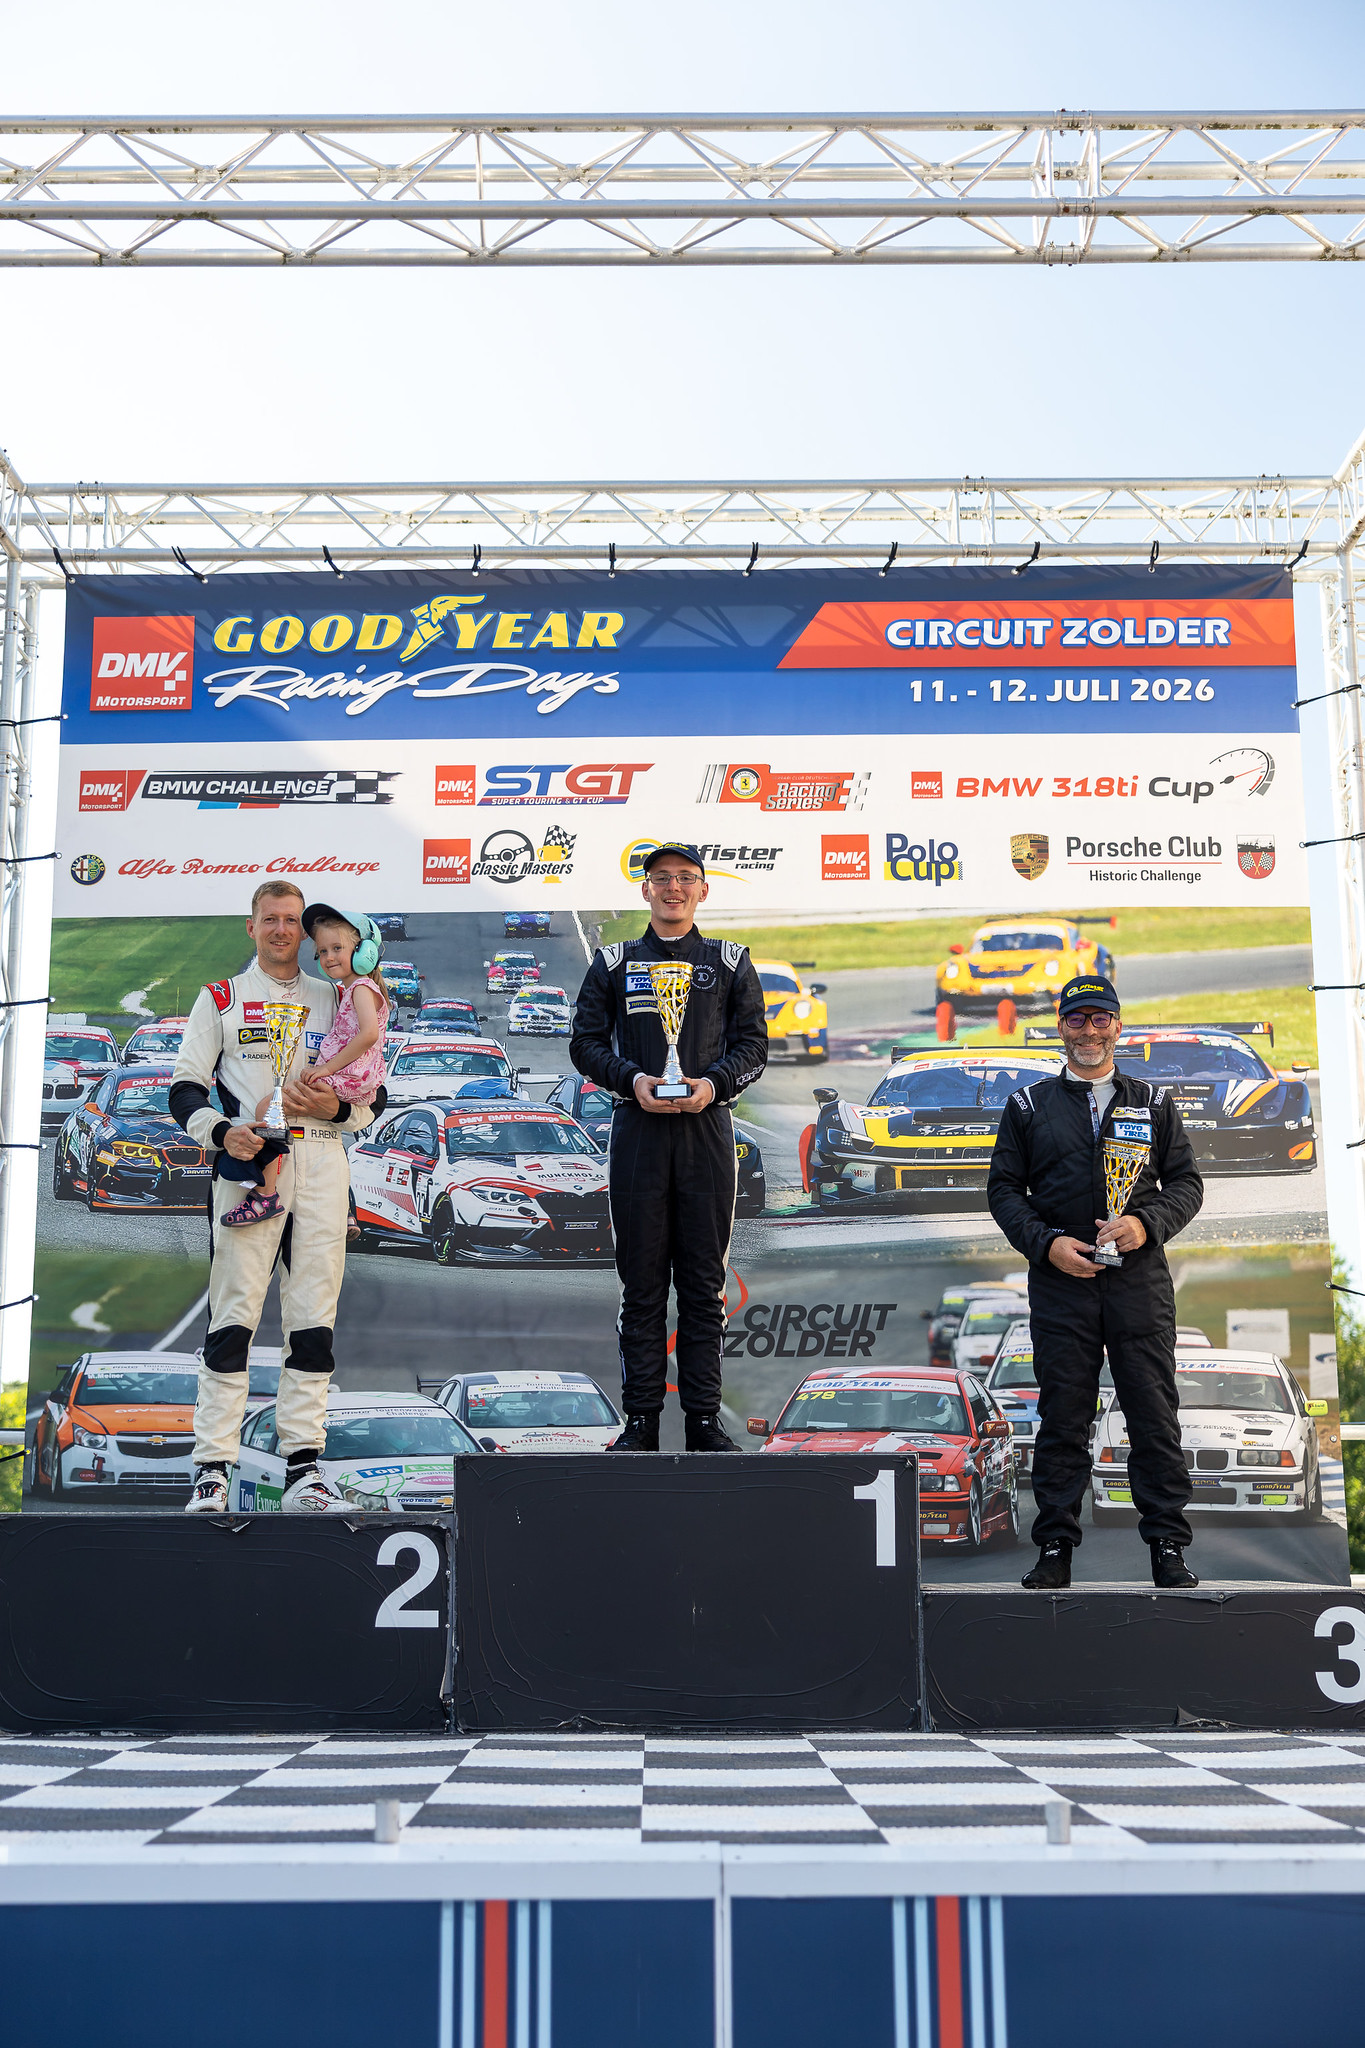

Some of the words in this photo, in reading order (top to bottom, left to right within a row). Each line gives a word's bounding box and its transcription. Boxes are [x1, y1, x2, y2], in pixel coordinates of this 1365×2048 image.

[886, 618, 1053, 648] CIRCUIT
[1061, 617, 1231, 647] ZOLDER
[97, 651, 187, 678] DMV
[203, 664, 407, 716] Racing
[406, 662, 620, 714] Days
[910, 679, 958, 702] 11.
[989, 679, 1037, 702] 12.
[1046, 679, 1119, 702] JULI
[1130, 678, 1215, 702] 2026
[82, 783, 123, 796] DMV
[147, 780, 205, 795] BMW
[205, 780, 330, 795] CHALLENGE
[437, 780, 474, 792] DMV
[483, 763, 656, 797] STGT
[913, 781, 941, 790] DMV
[956, 777, 1043, 797] BMW
[1051, 775, 1139, 797] 318ti
[1148, 776, 1215, 804] Cup
[491, 797, 522, 805] SUPER
[524, 797, 563, 805] TOURING
[776, 782, 840, 801] Racing
[765, 795, 824, 809] Series
[886, 833, 959, 862] Polo
[1066, 836, 1162, 858] Porsche
[1168, 835, 1222, 857] Club
[118, 858, 178, 879] Alfa
[180, 858, 264, 875] Romeo
[265, 855, 380, 876] Challenge
[425, 855, 468, 869] DMV
[734, 861, 775, 871] racing
[824, 851, 867, 865] DMV
[471, 861, 519, 876] Classic
[520, 861, 574, 876] Masters
[890, 853, 956, 887] Cup
[1089, 870, 1138, 881] Historic
[1141, 869, 1201, 884] Challenge
[132, 1078, 155, 1087] DMV
[458, 1116, 484, 1125] DMV
[488, 1114, 512, 1122] BMW
[513, 1114, 559, 1123] Challenge
[1123, 1130, 1149, 1139] TIRES
[743, 1303, 898, 1331] CIRCUIT
[722, 1329, 876, 1358] ZOLDER
[468, 1399, 486, 1408] 31
[796, 1390, 837, 1401] 478
[361, 1466, 401, 1478] Top
[241, 1488, 254, 1511] Top
[256, 1491, 281, 1511] Expres
[853, 1469, 896, 1567] 1
[374, 1531, 440, 1628] 2
[1314, 1605, 1365, 1704] 3
